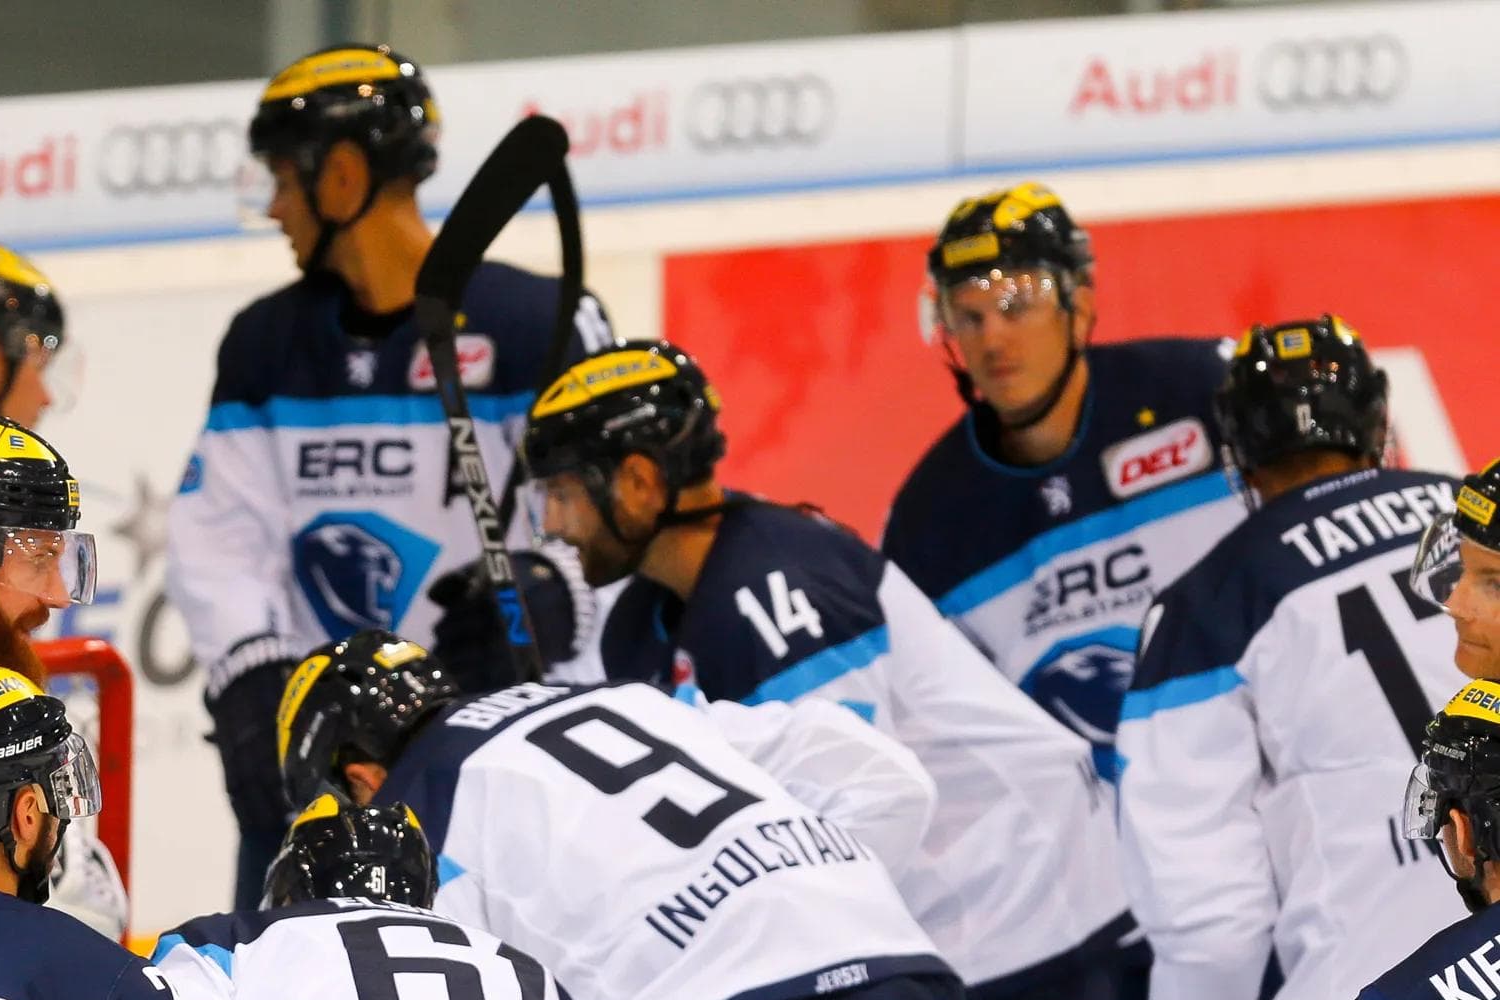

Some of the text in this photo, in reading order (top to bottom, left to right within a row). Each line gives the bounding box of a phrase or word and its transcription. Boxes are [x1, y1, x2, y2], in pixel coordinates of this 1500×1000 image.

[1068, 52, 1242, 116] Audi
[512, 98, 672, 158] udi
[296, 439, 414, 480] ERC
[449, 416, 514, 582] NEXUS
[734, 570, 825, 660] 14
[1462, 687, 1500, 715] EDEK
[525, 705, 767, 850] 9
[644, 814, 871, 950] INGOLSTADT
